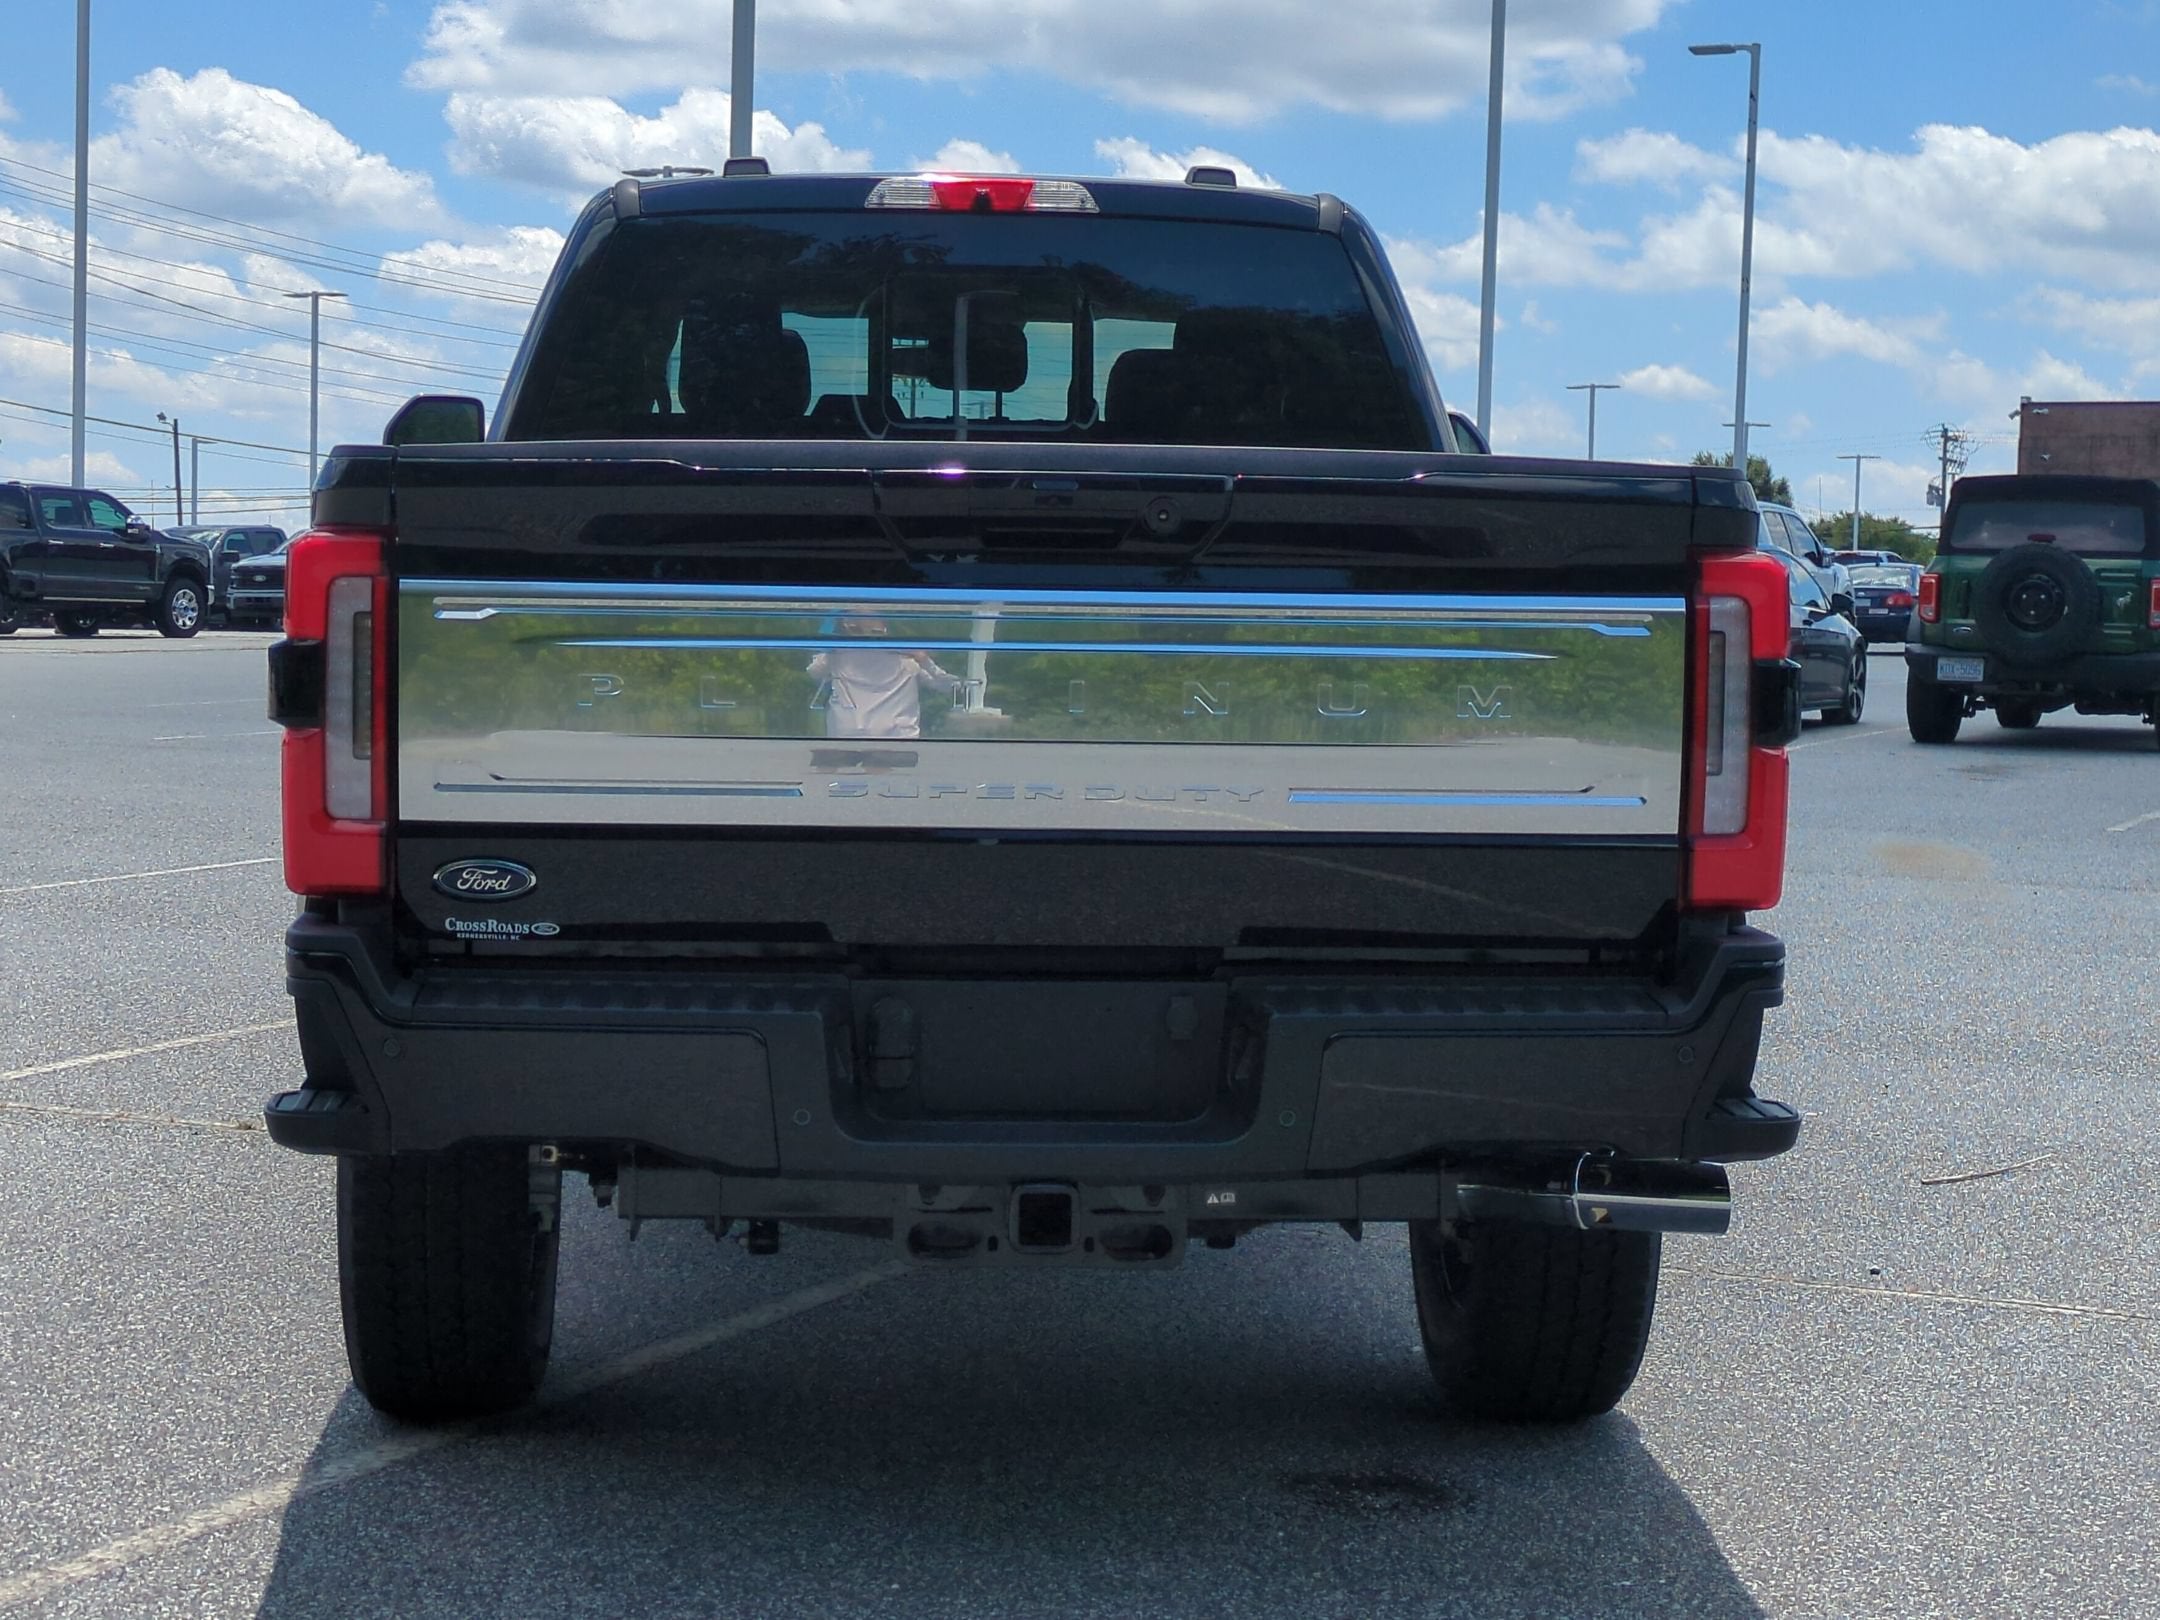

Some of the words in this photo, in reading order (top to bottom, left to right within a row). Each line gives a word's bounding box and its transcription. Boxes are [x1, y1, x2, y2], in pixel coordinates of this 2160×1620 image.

[576, 673, 1512, 718] PLATINUM
[828, 782, 1064, 800] SUPER
[1085, 785, 1265, 802] DUTY
[456, 867, 512, 891] Ford
